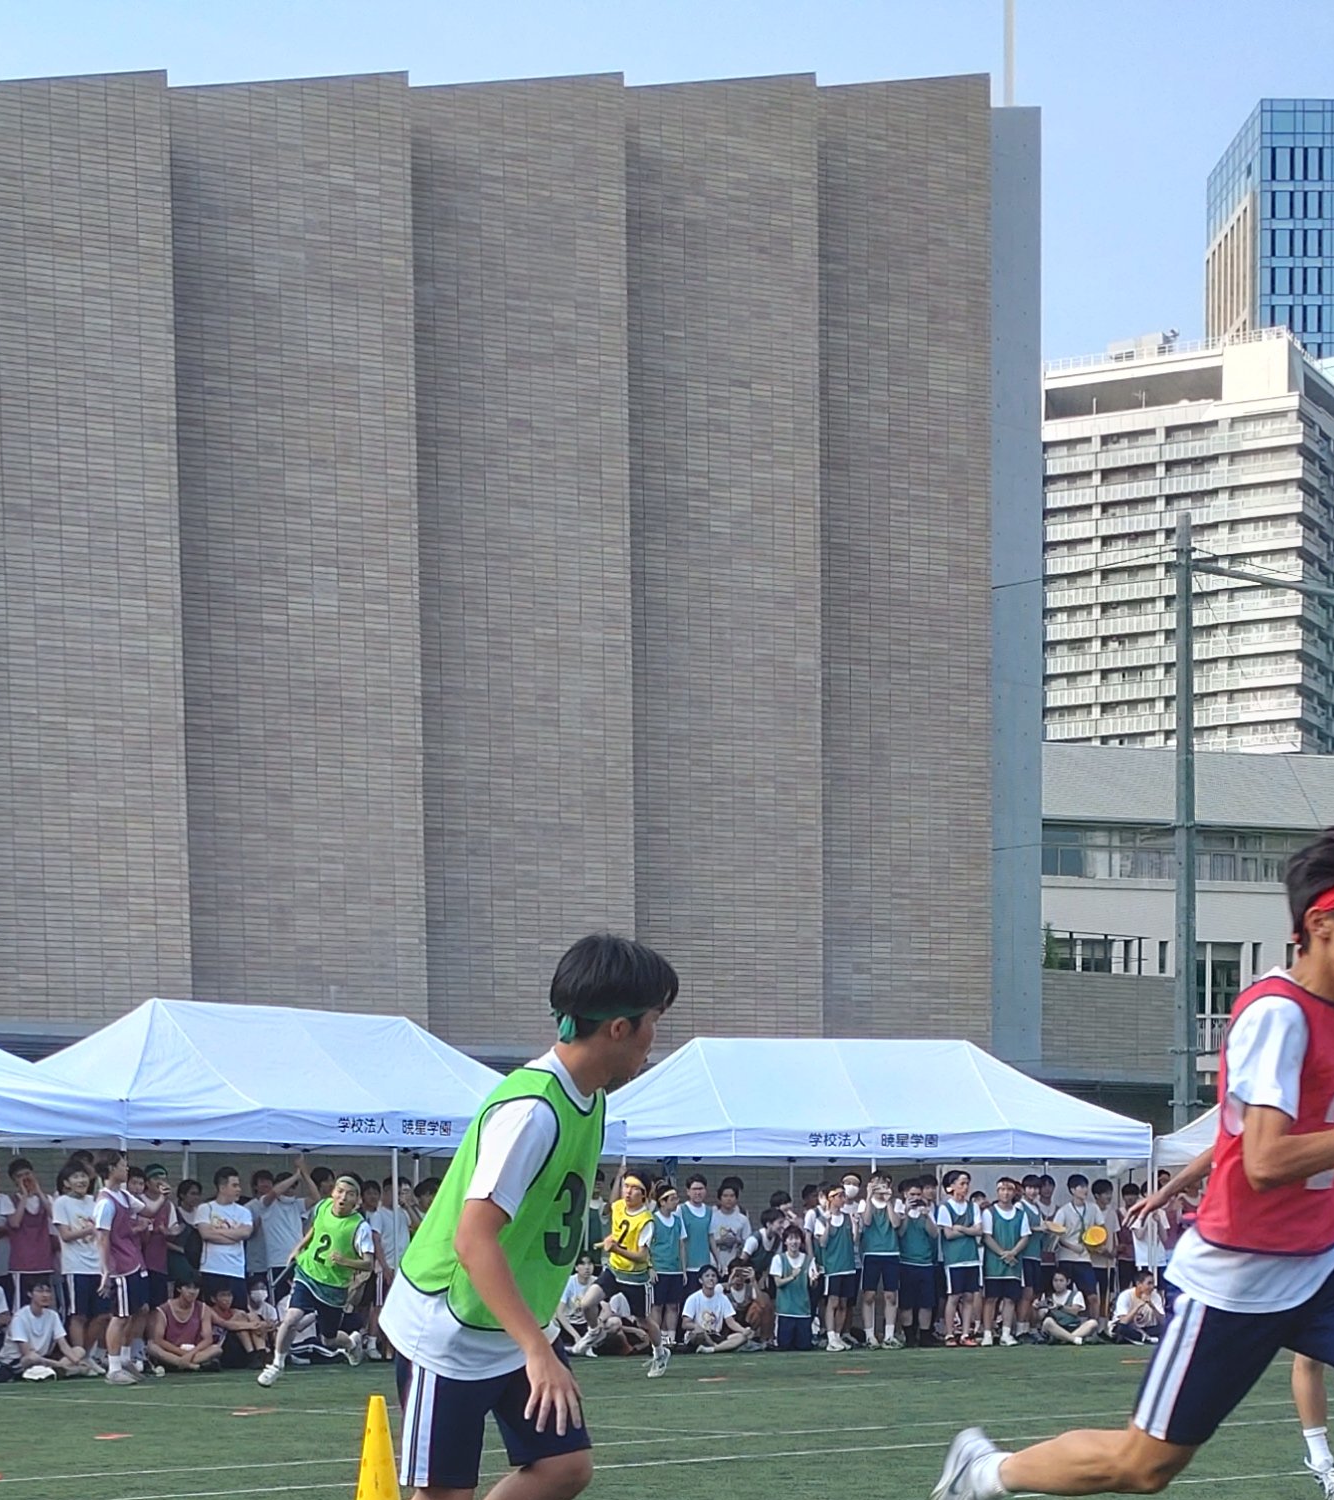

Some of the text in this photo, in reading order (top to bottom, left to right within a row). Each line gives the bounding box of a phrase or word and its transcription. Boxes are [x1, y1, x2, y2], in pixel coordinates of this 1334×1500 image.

[338, 1117, 389, 1135] 学校法人
[809, 1133, 866, 1147] 学校法人
[544, 1171, 586, 1267] 3
[618, 1219, 634, 1251] 2
[314, 1233, 332, 1265] 2
